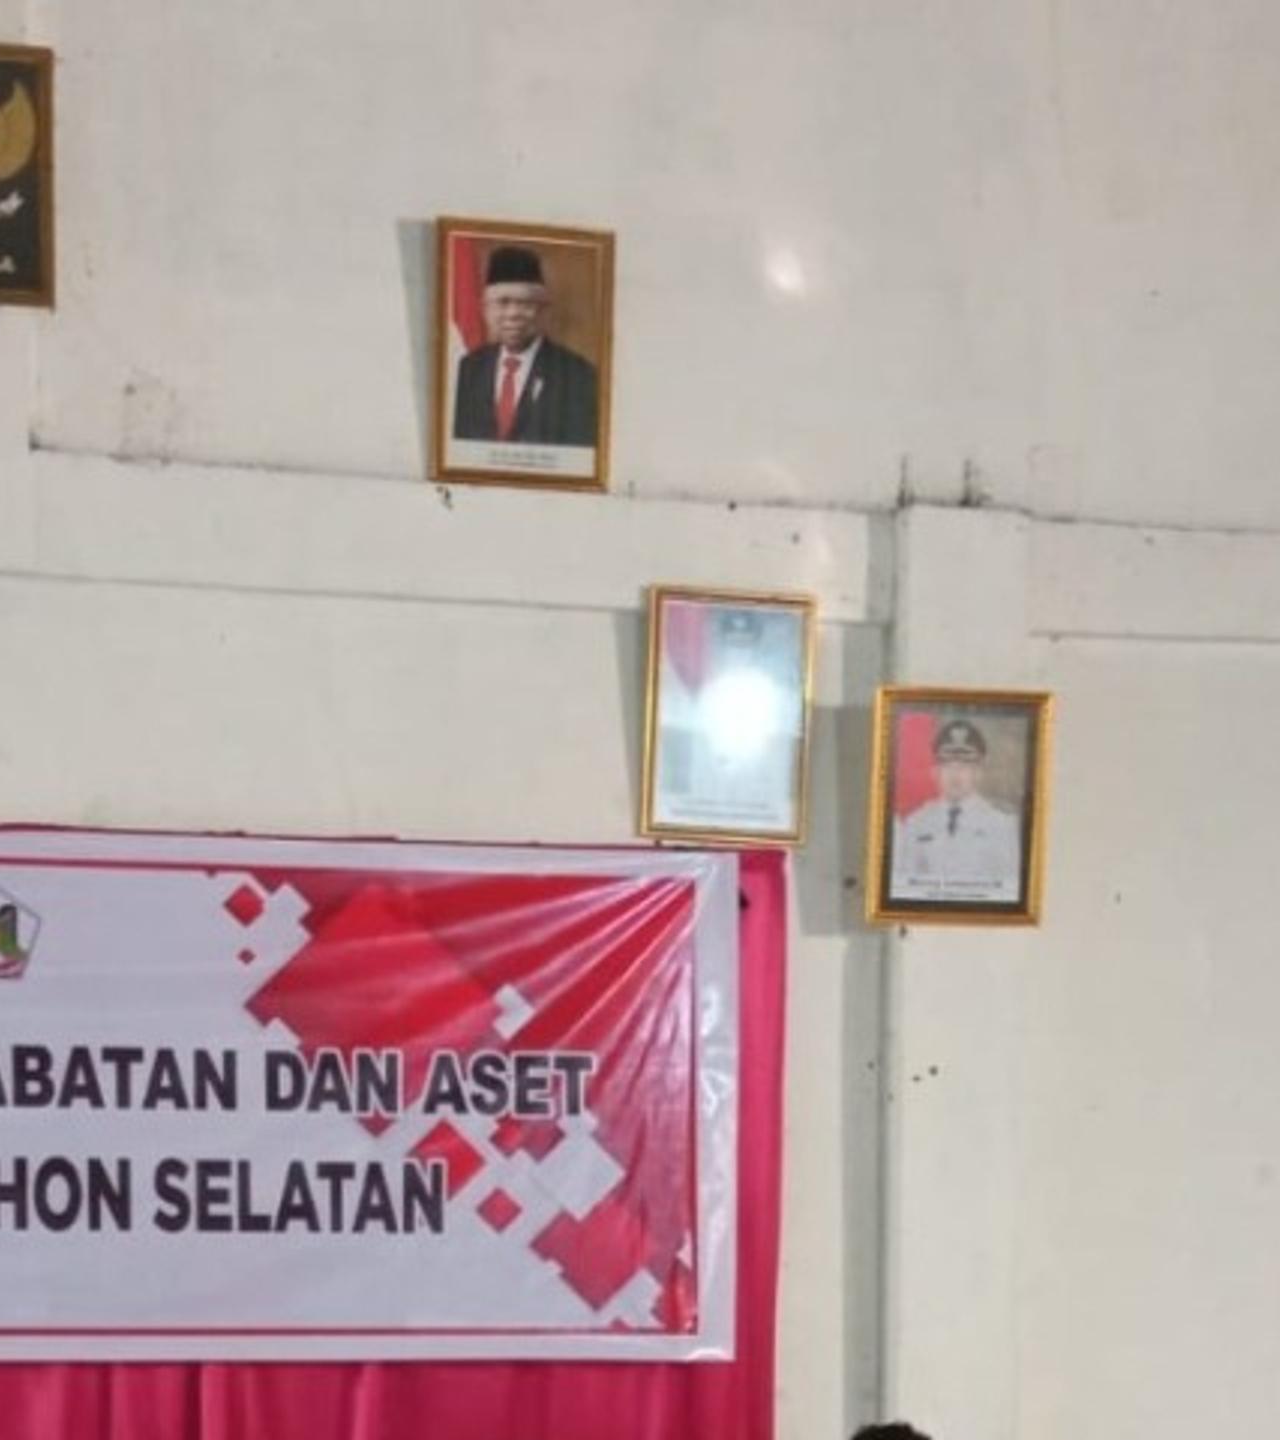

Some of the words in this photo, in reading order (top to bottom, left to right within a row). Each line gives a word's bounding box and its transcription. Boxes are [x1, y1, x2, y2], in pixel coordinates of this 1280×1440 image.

[265, 1050, 401, 1113] DAN
[423, 1054, 594, 1116] ASET
[153, 1158, 446, 1234] SELATAN
